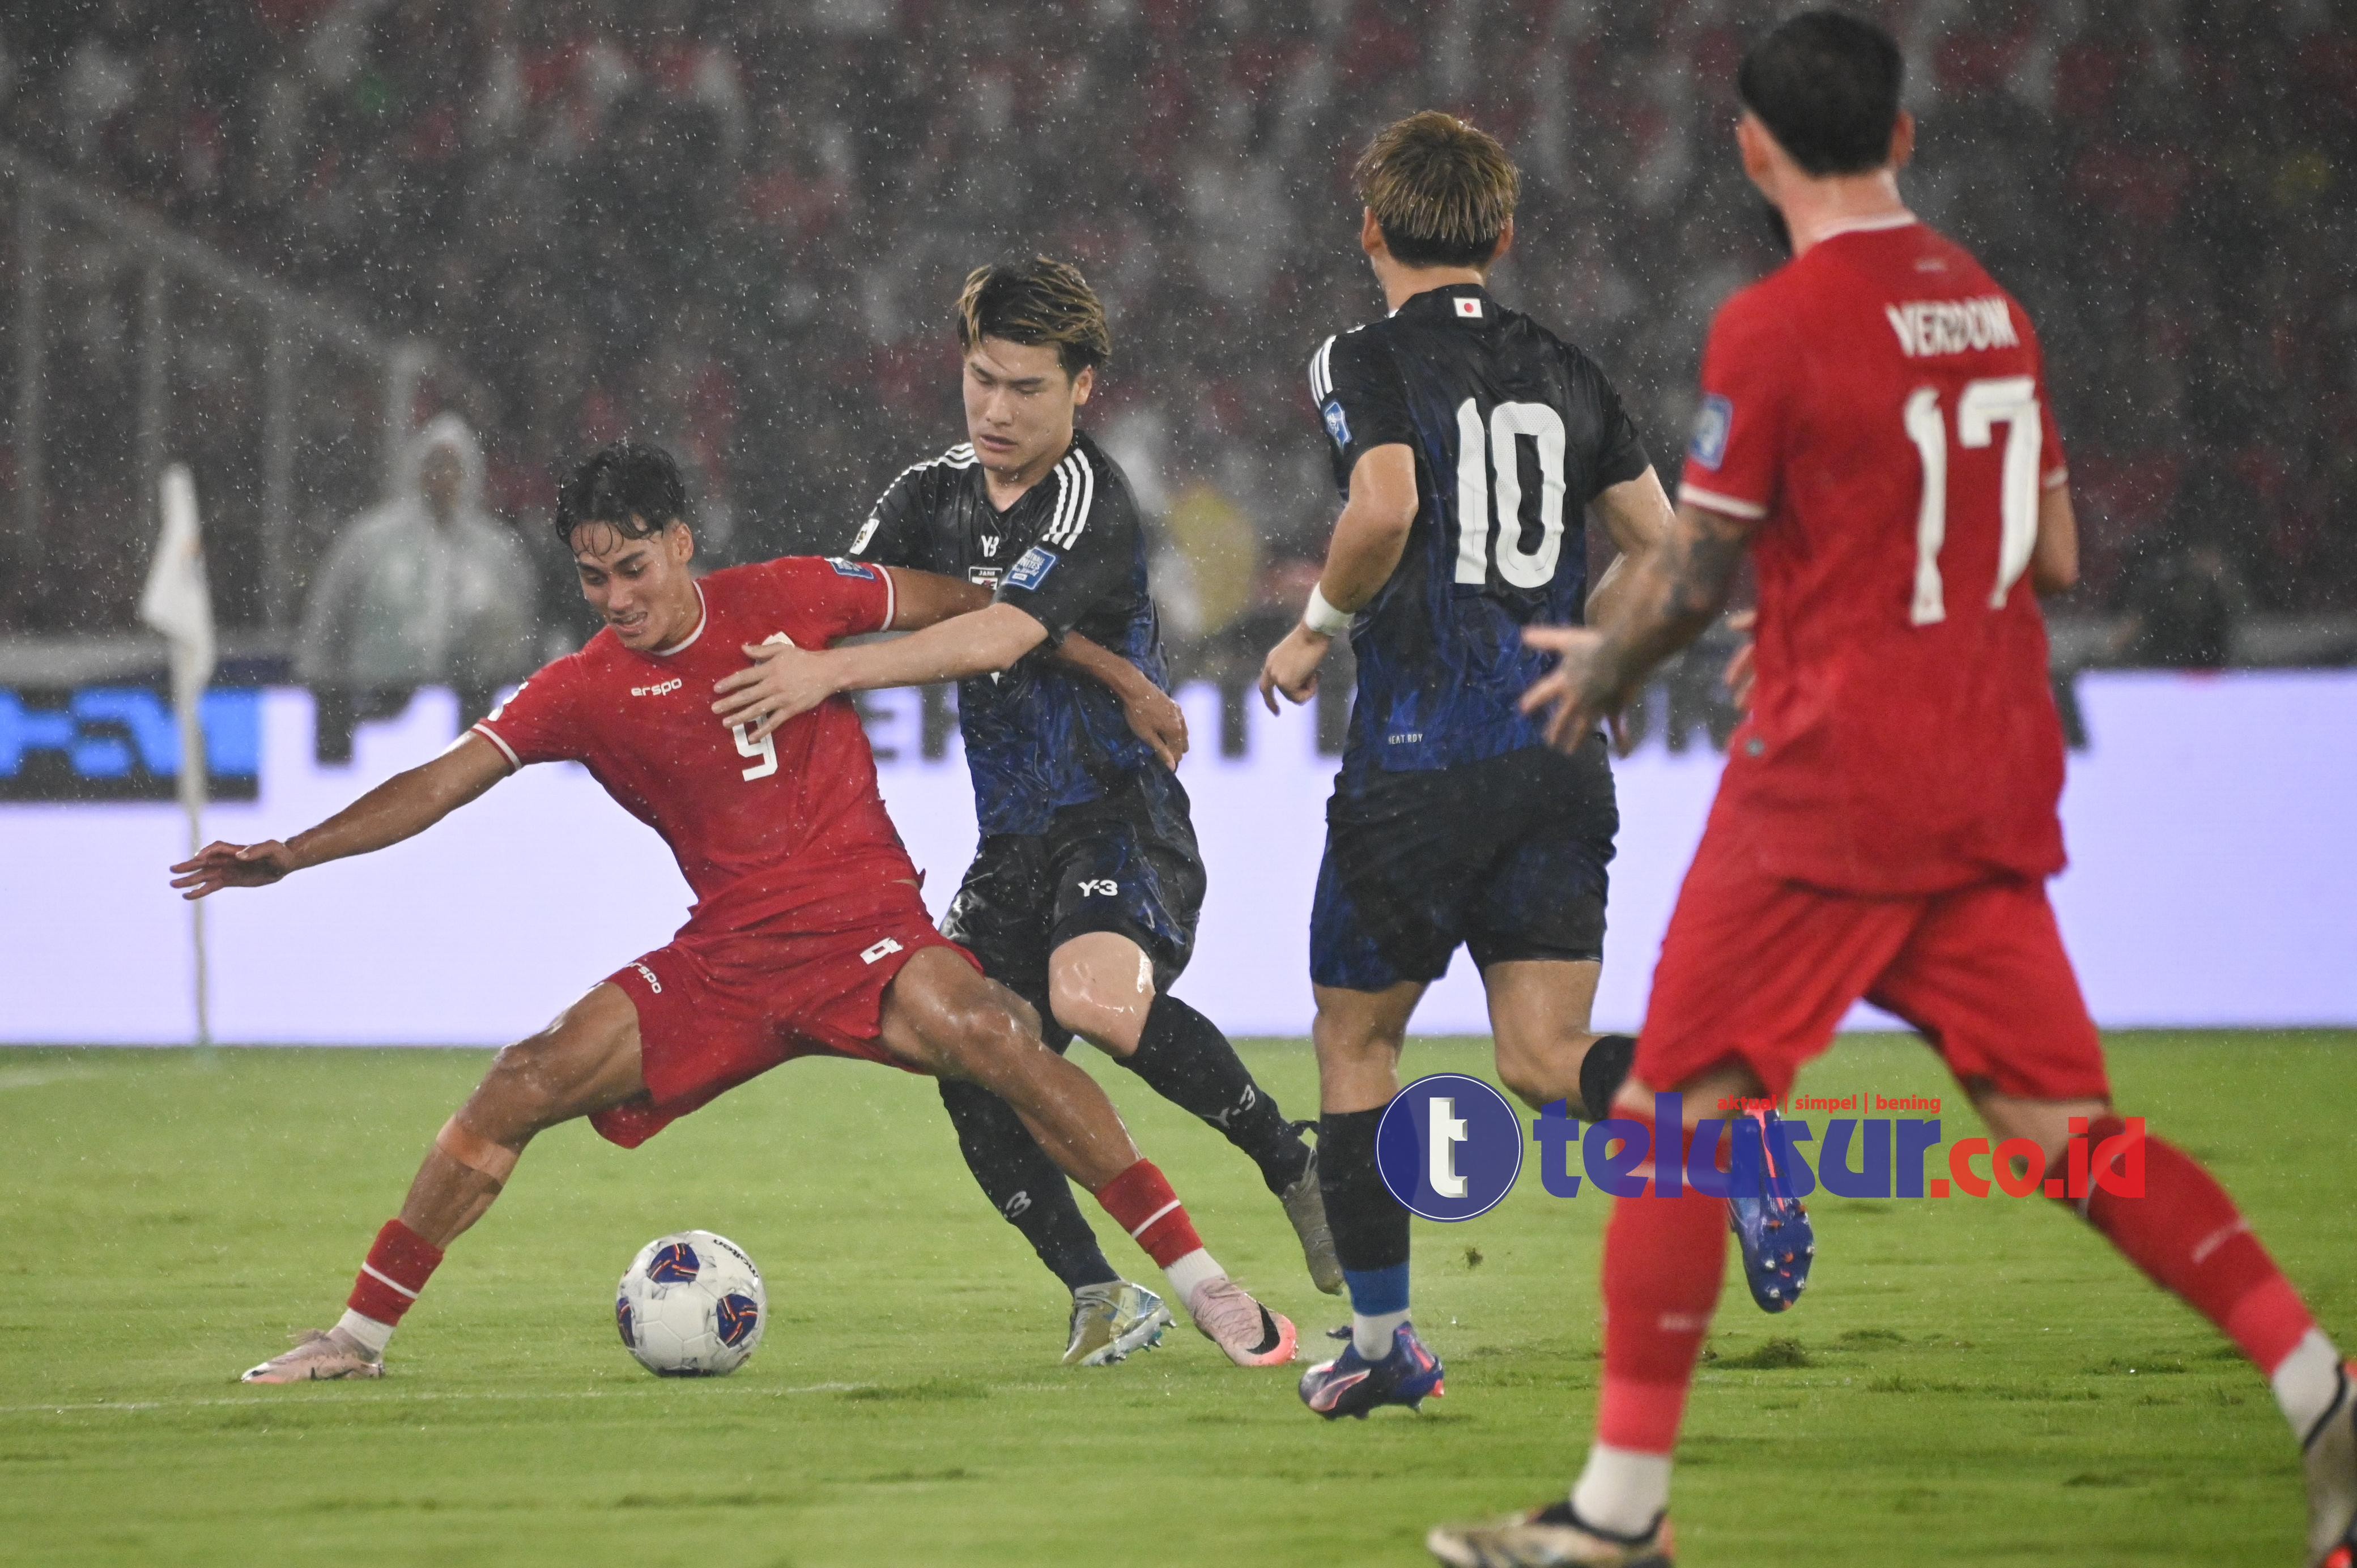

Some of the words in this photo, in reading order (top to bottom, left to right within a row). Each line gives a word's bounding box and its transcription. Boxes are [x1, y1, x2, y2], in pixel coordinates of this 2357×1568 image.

[1454, 398, 1566, 589] 10
[1904, 376, 2042, 625] 17
[631, 678, 682, 696] erspo
[732, 712, 778, 782] 9
[1078, 879, 1118, 897] Y-3
